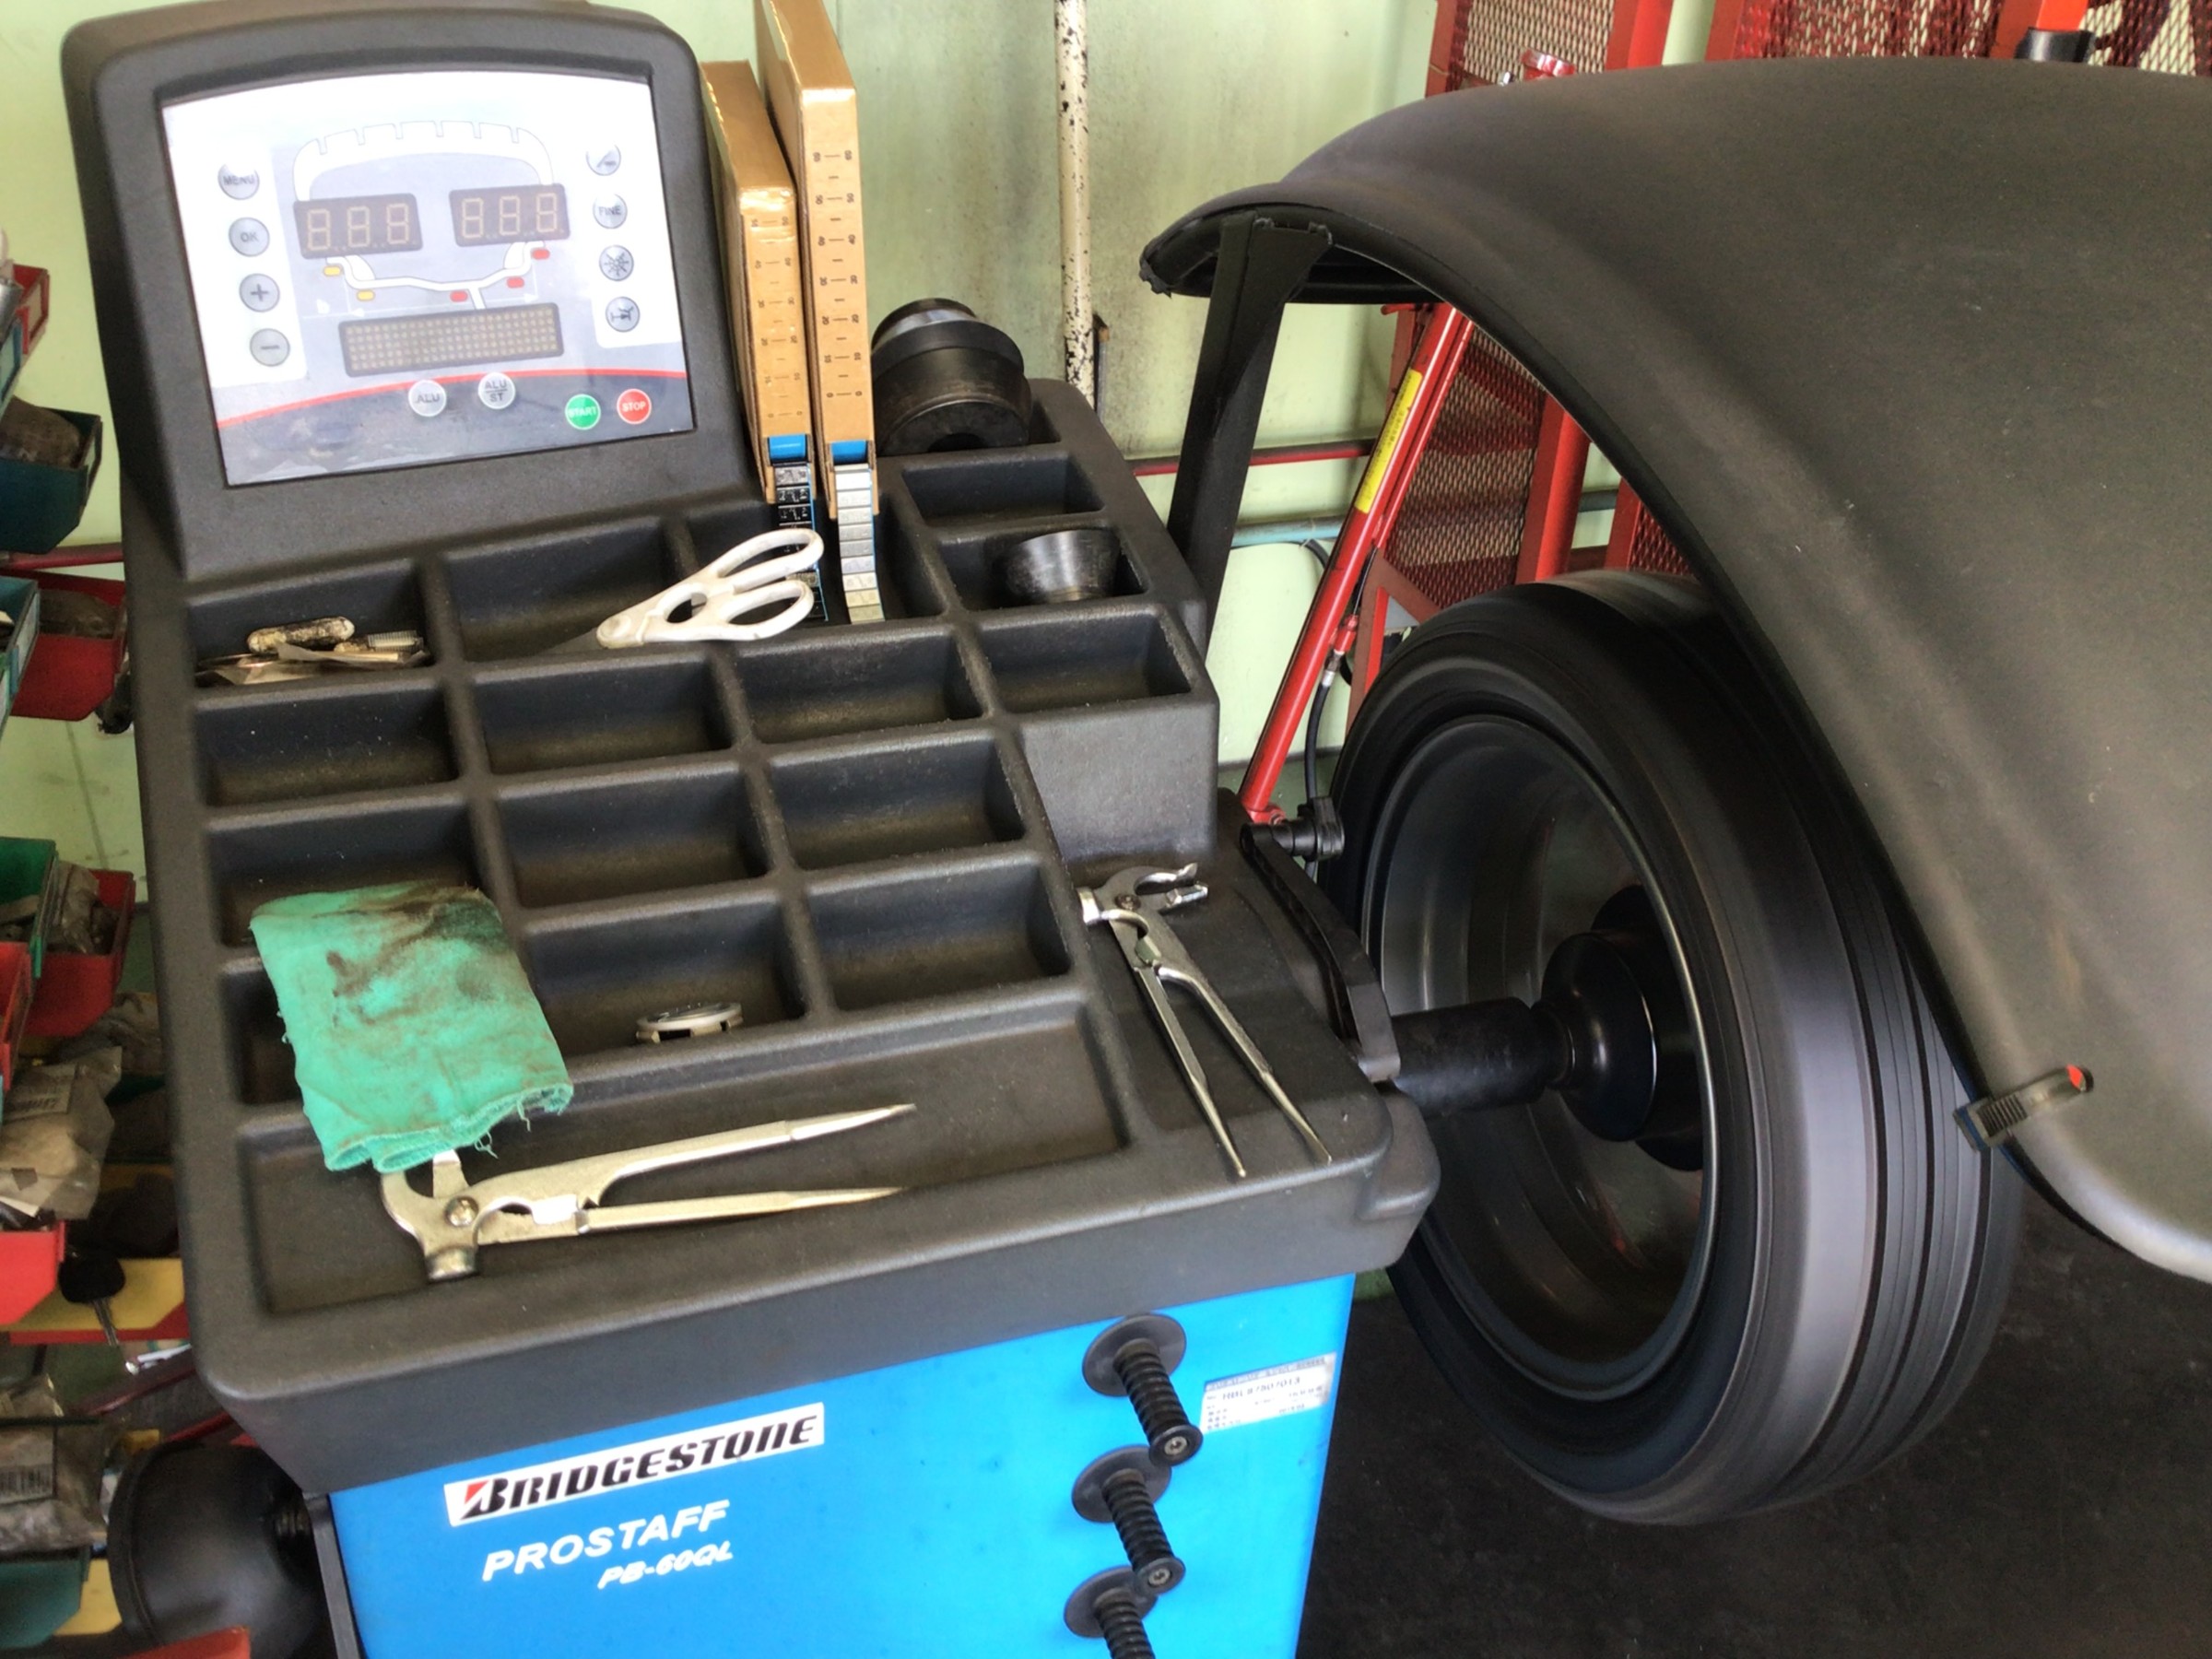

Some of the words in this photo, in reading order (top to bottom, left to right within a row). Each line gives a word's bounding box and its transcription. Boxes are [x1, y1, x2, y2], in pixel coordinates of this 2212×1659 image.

[222, 173, 255, 185] MENU
[599, 205, 622, 217] FINE
[240, 231, 259, 243] OK
[485, 379, 508, 390] ALU
[415, 393, 441, 404] ALU
[488, 393, 505, 403] ST
[568, 406, 597, 418] START
[622, 401, 646, 413] STOP
[460, 1415, 818, 1521] BRIDGESTONE
[482, 1500, 730, 1582] PROSTAFF
